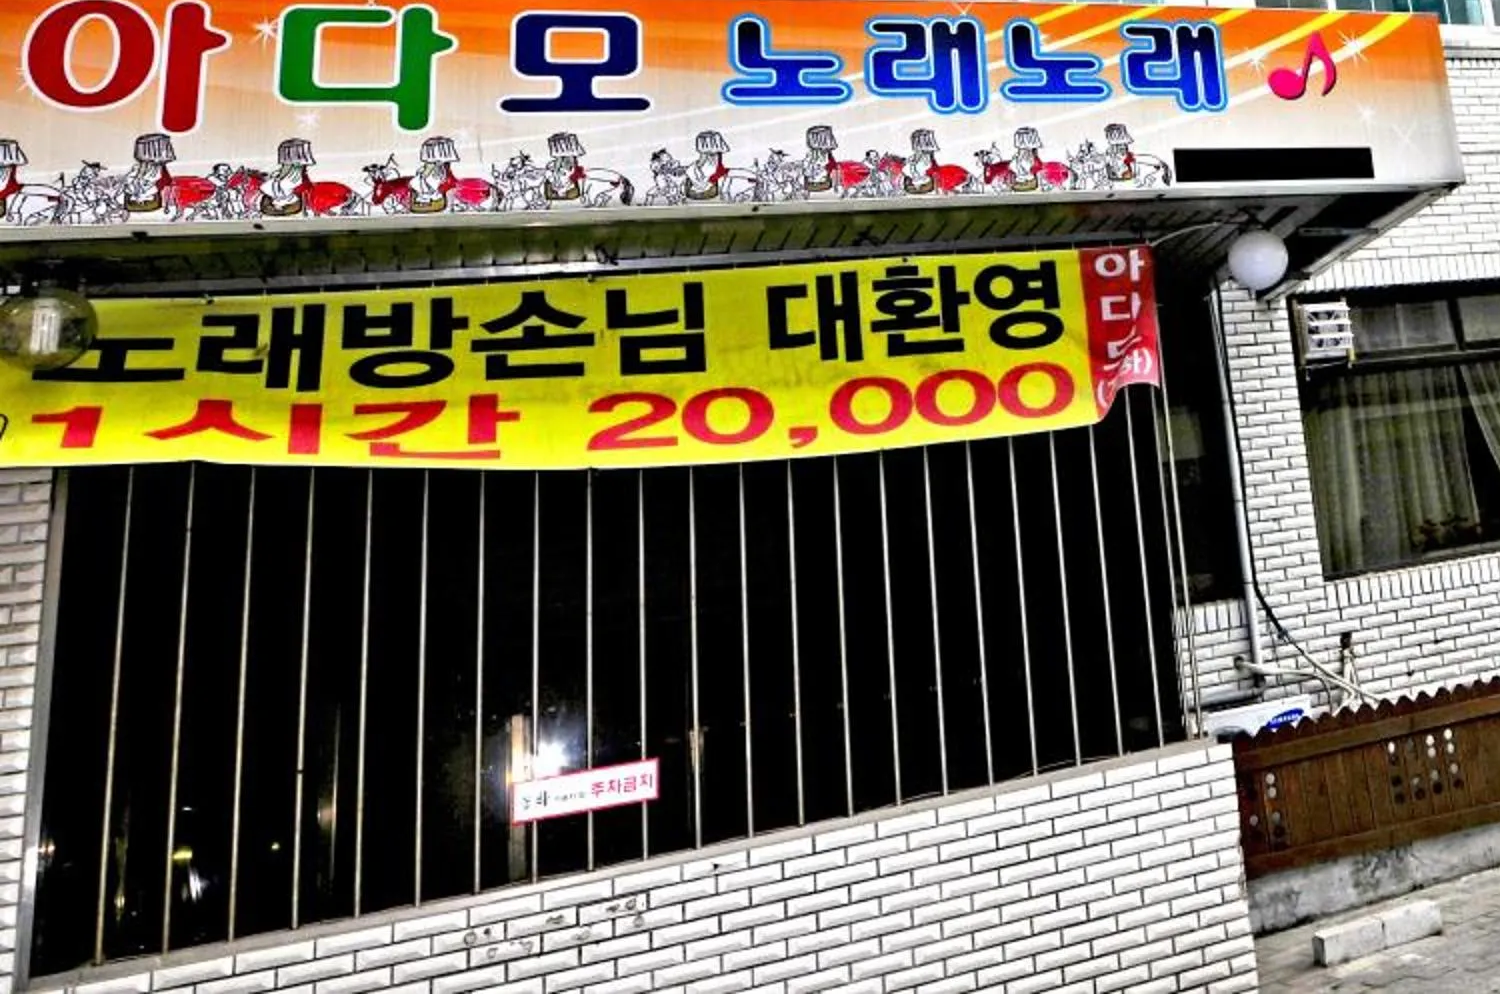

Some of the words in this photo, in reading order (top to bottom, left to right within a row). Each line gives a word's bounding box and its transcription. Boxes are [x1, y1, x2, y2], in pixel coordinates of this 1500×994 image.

[718, 11, 1230, 114] 노래노래
[32, 281, 707, 396] 노래방손님
[765, 258, 1064, 363] 대환영
[30, 391, 520, 461] 1시간
[586, 359, 1076, 452] 20,000
[592, 773, 653, 798] 주차금지
